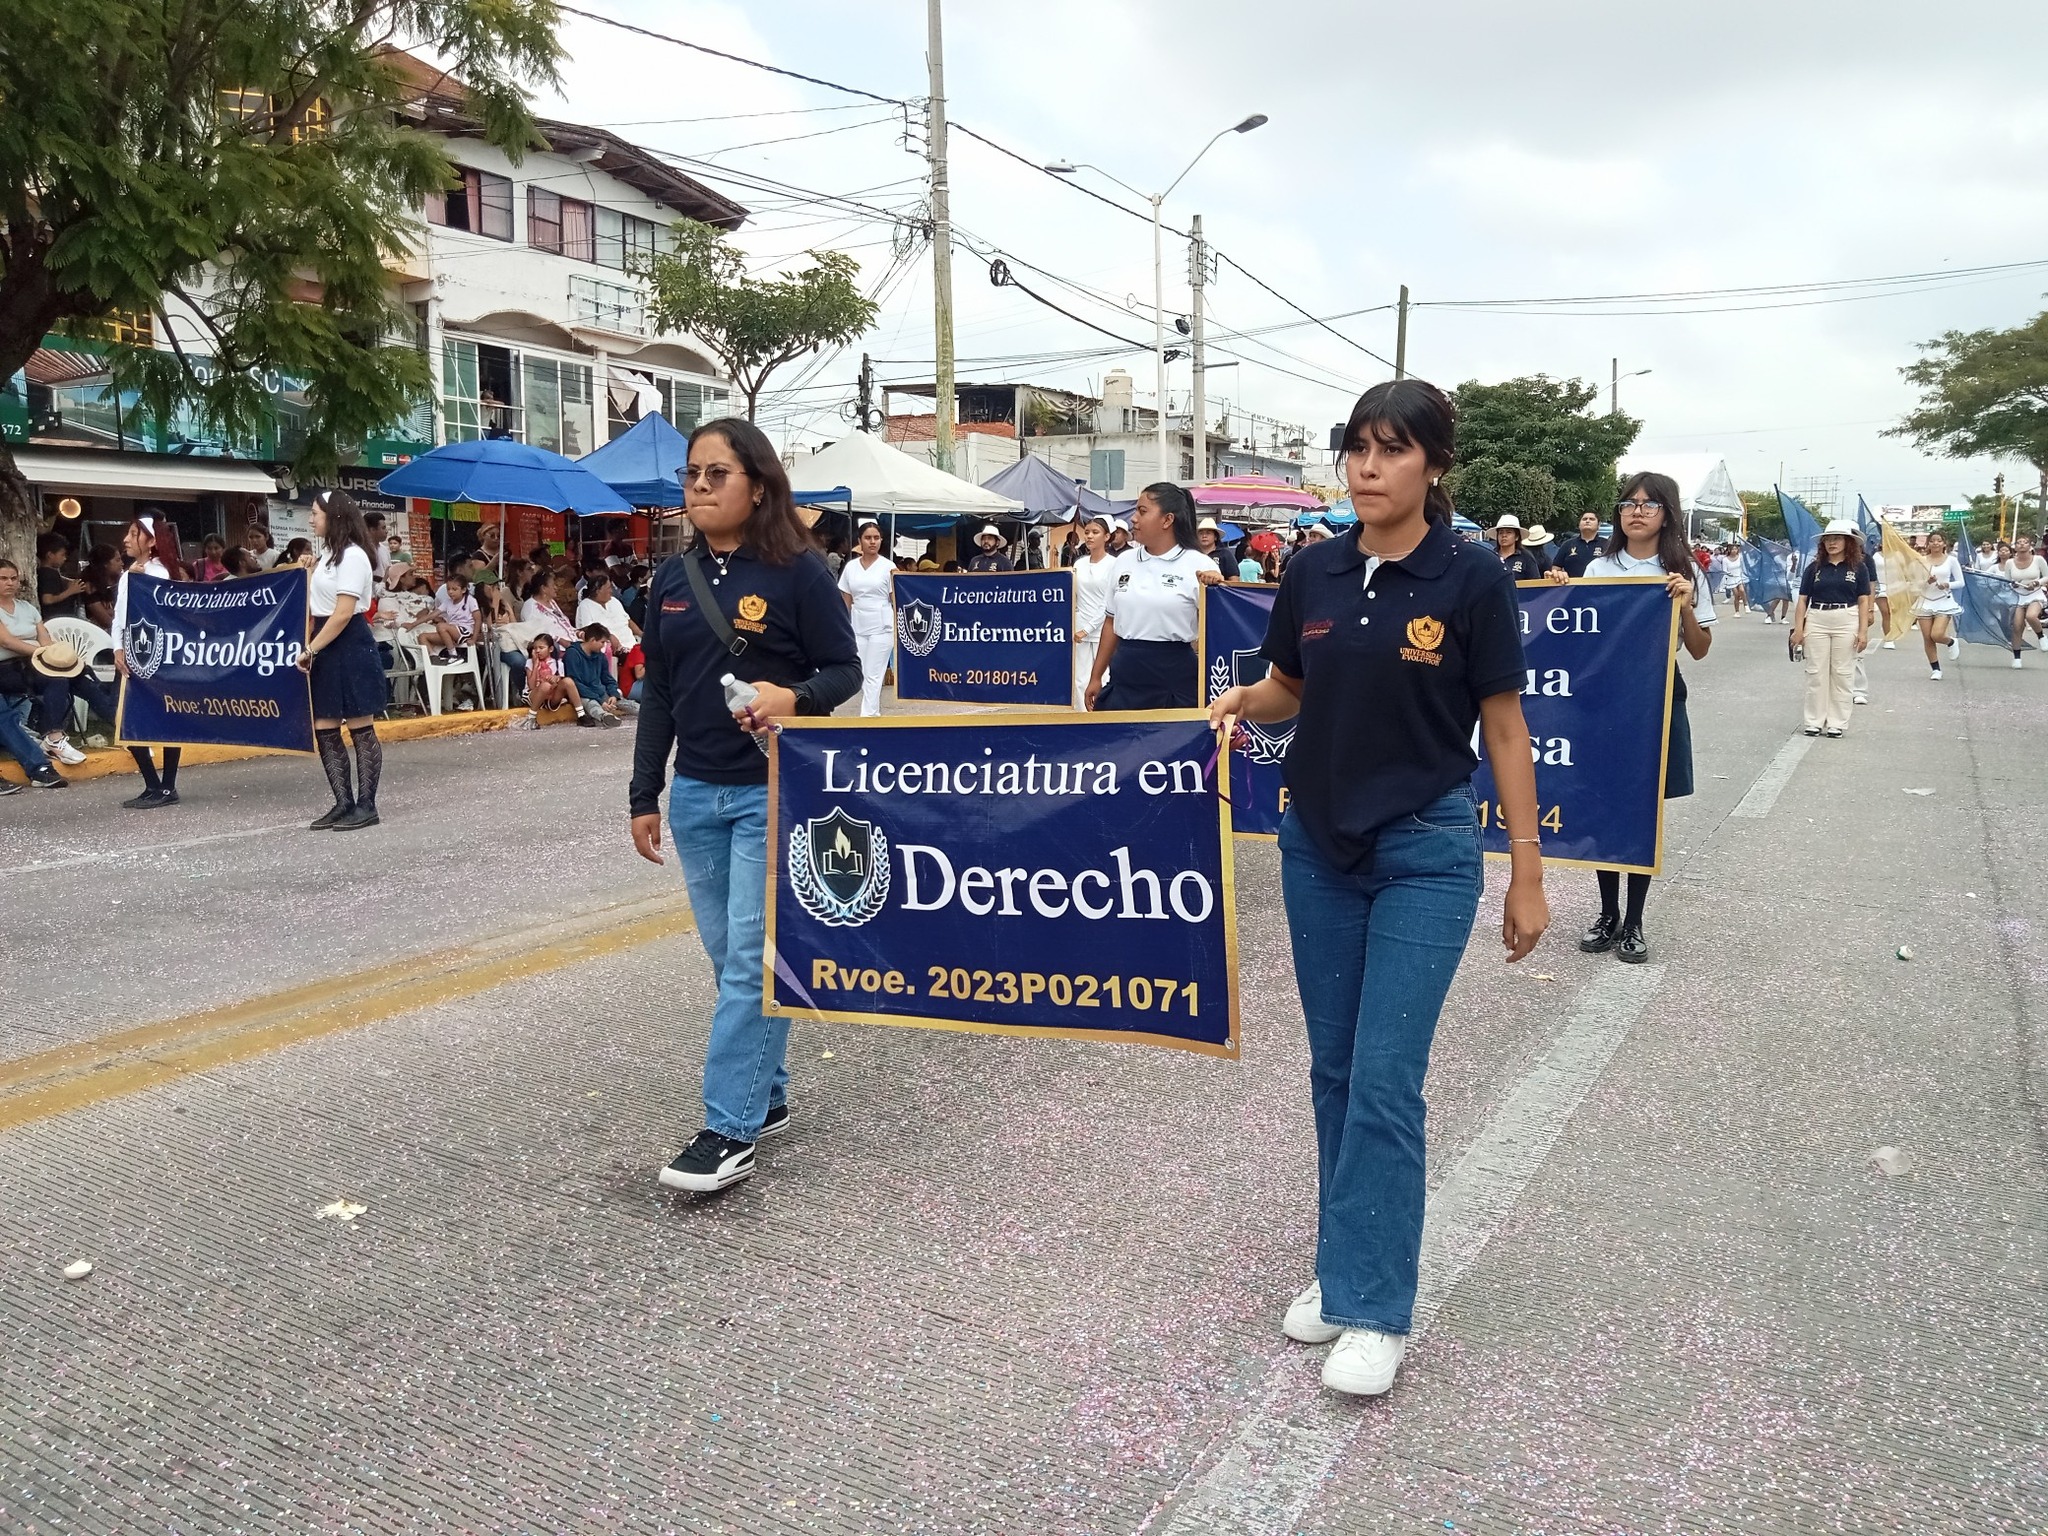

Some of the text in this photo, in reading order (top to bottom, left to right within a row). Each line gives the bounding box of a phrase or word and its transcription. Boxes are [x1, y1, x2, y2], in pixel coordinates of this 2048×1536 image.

[309, 476, 379, 492] NBURS
[153, 584, 277, 609] Licenciatura en
[942, 585, 1065, 605] Licenciatura en
[943, 621, 1066, 643] Enfermería
[1546, 605, 1601, 634] en
[163, 629, 302, 677] Psicología
[929, 668, 1038, 686] Rvoe: 20180154
[164, 694, 281, 718] Rvoe: 20160580
[822, 748, 1208, 796] Licenciatura en
[896, 843, 1214, 923] Derecho
[812, 958, 1199, 1017] Rvoe. 2023P021071
